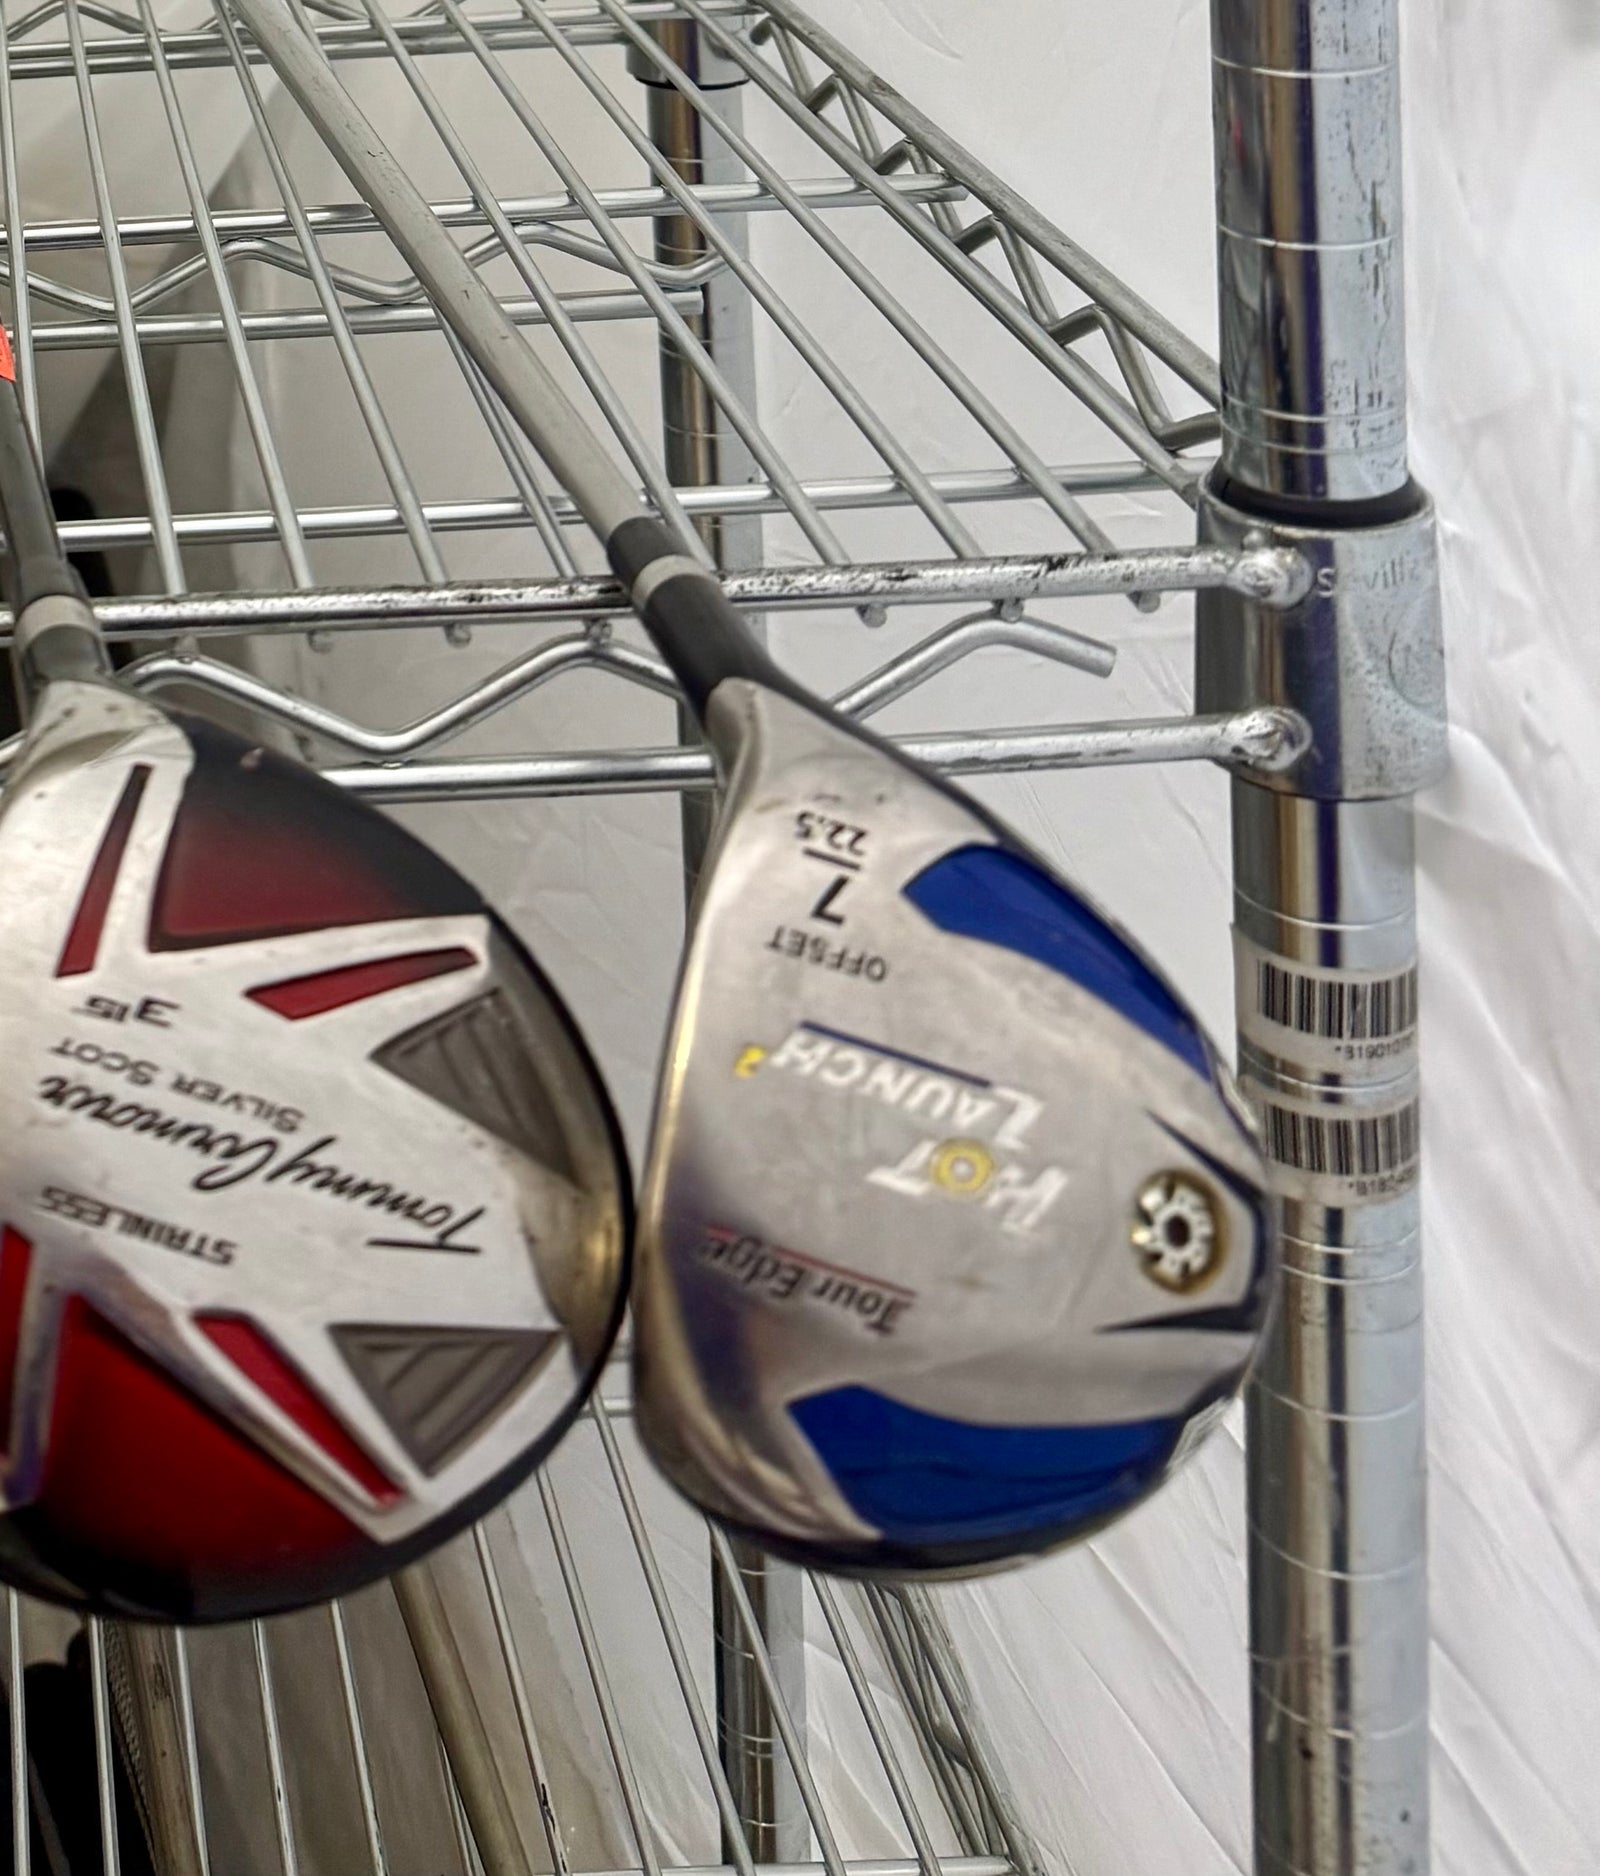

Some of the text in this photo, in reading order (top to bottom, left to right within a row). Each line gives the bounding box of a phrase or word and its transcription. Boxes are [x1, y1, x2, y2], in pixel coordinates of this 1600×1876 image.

[793, 810, 866, 856] 22.5
[812, 876, 851, 923] 7
[765, 925, 887, 983] OFFSET
[47, 1038, 306, 1134] SILVER SCOT
[39, 1075, 486, 1256] Tommy Armour
[865, 1136, 1069, 1234] HOT
[700, 1231, 908, 1336] Tour Edge
